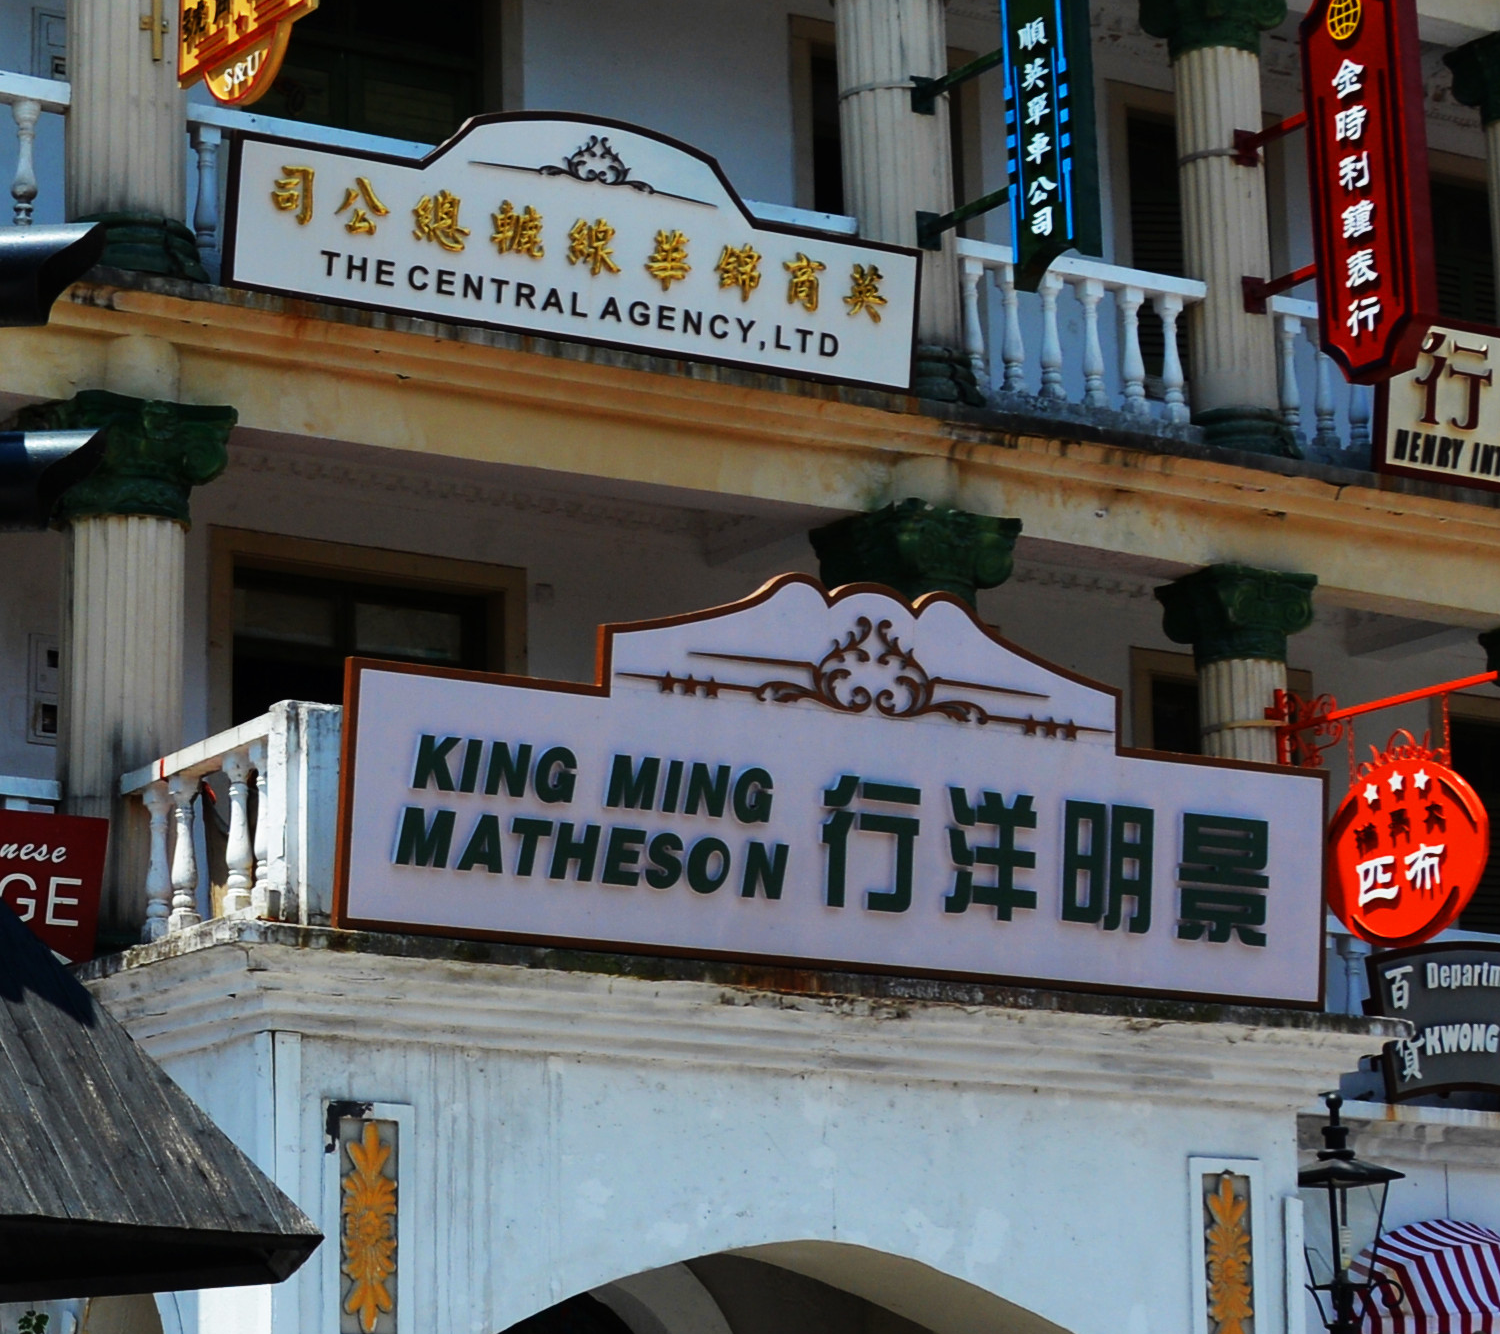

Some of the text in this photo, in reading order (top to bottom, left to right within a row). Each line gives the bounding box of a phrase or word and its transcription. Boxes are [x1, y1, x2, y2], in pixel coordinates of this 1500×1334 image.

[224, 50, 262, 92] S&U
[1017, 17, 1057, 236] 順英單車公司
[1331, 59, 1381, 339] 金時利鐘表行
[319, 249, 395, 287] THE
[406, 265, 589, 320] CENTRAL
[1393, 429, 1465, 464] HENRY
[412, 733, 774, 825] KING MING
[394, 806, 790, 901] MATHESON
[1425, 1023, 1500, 1056] KWONG
